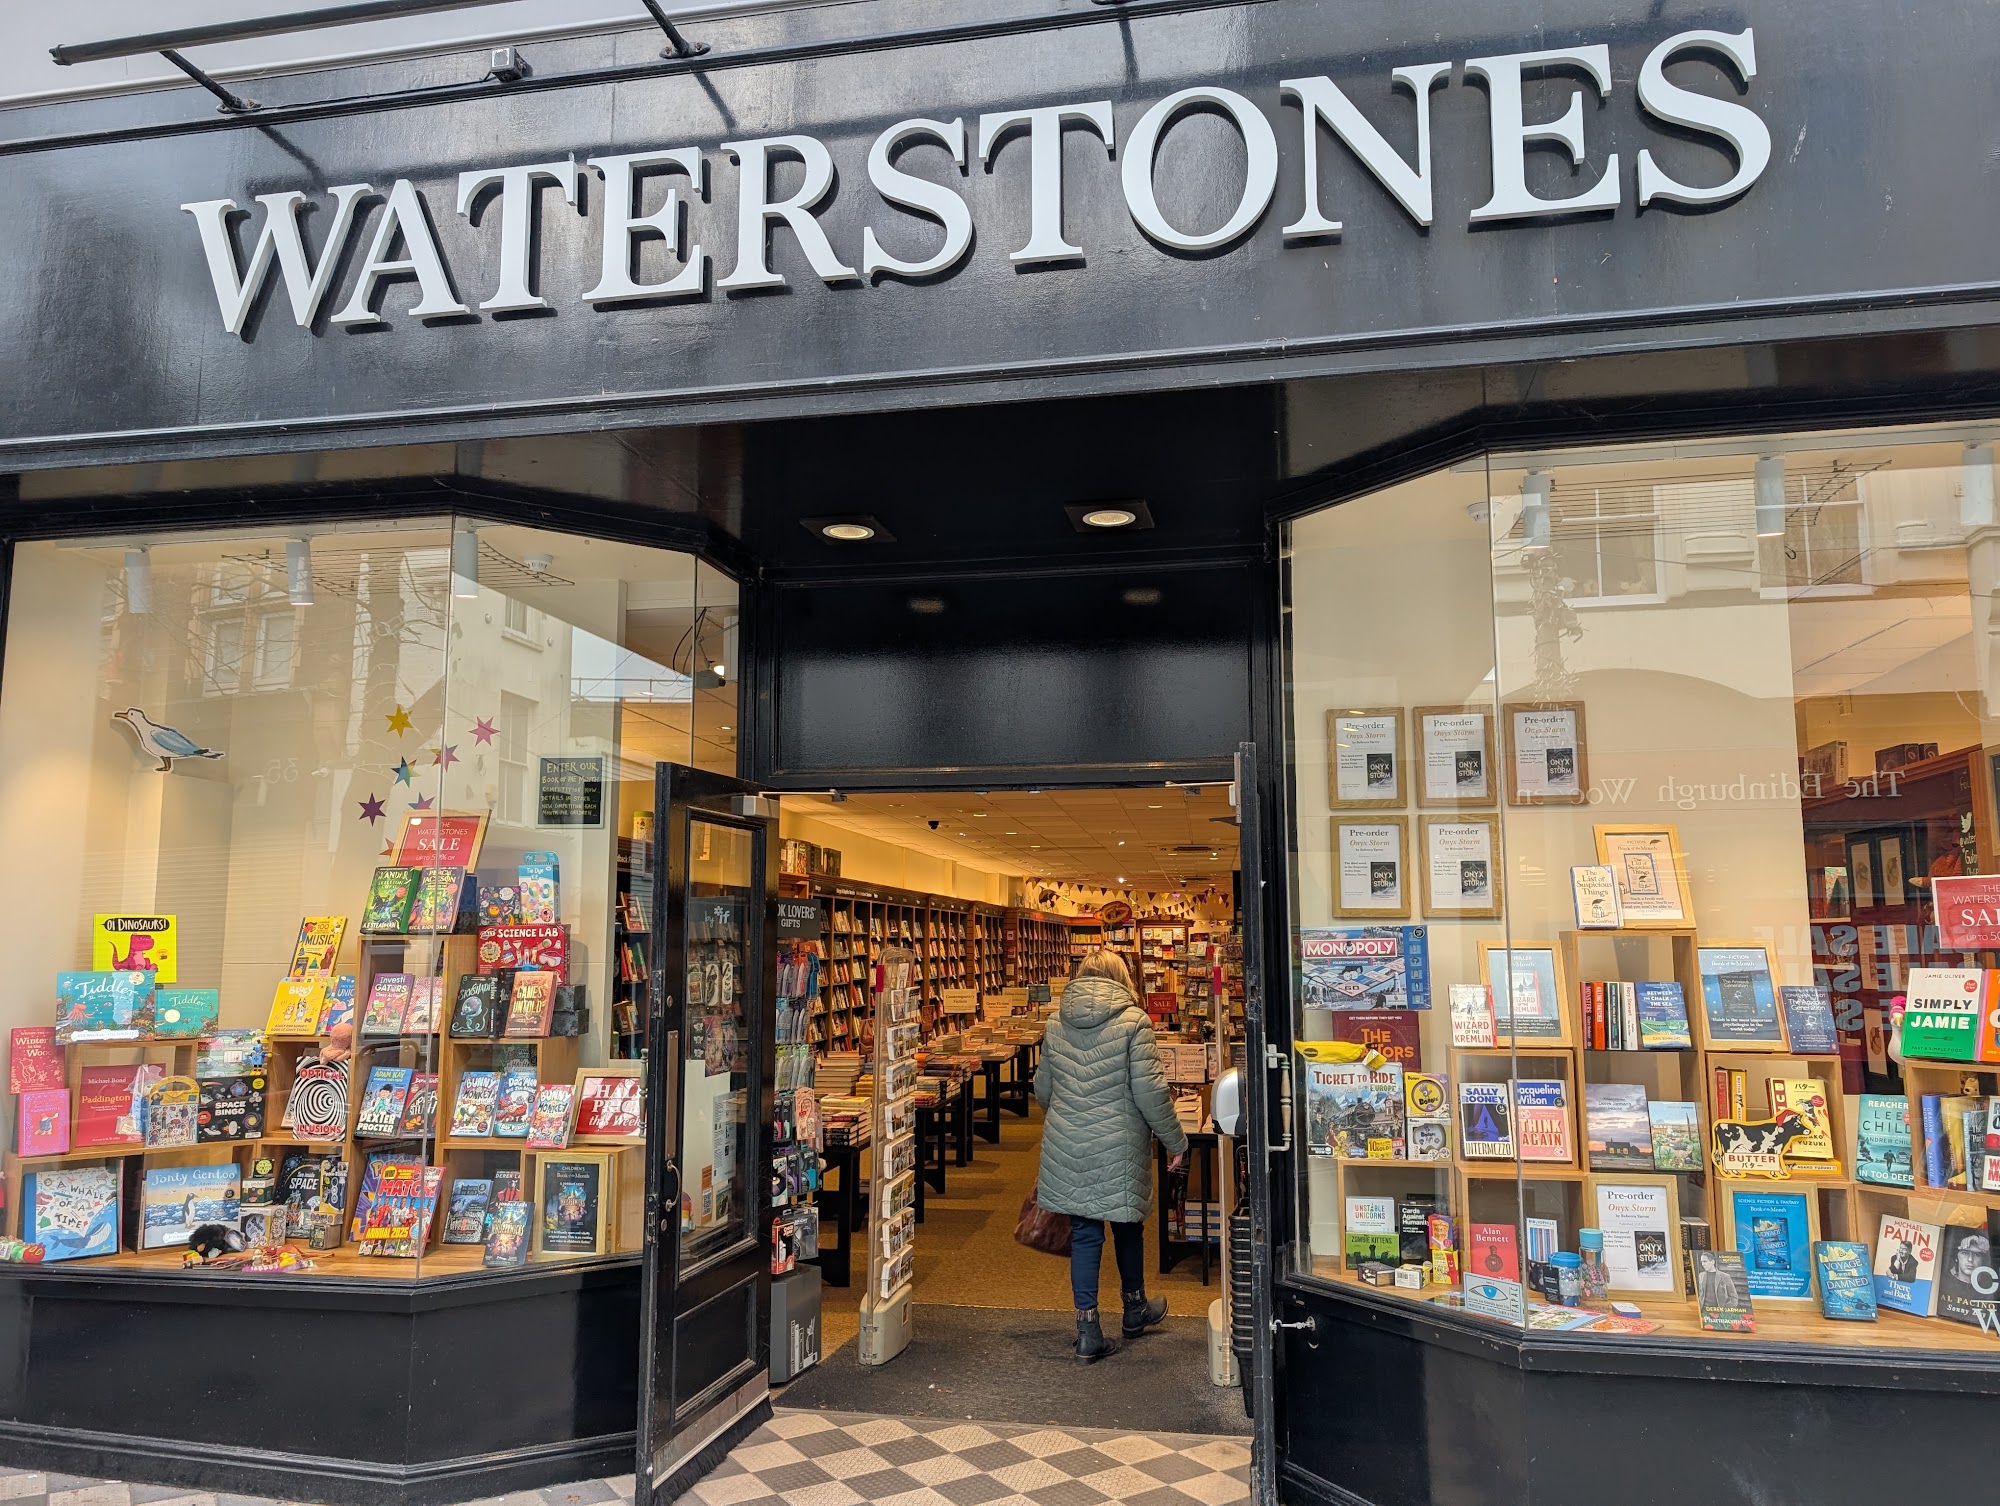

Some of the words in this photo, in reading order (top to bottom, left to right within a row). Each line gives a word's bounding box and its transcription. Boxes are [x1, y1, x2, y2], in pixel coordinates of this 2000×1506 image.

[181, 28, 1774, 338] WATERSTONES
[1524, 716, 1565, 724] Pre-order
[546, 762, 579, 773] ENTER
[580, 762, 599, 772] OUR
[1349, 829, 1389, 837] Pre-order
[1439, 828, 1479, 836] Pre-order
[416, 837, 461, 851] SALE
[1349, 839, 1367, 847] Onyx
[1438, 838, 1457, 846] Onyx
[1373, 871, 1393, 879] ONYX
[1464, 870, 1483, 878] ONYX
[1373, 880, 1395, 888] STORM
[1464, 879, 1486, 887] STORM
[1982, 884, 2000, 892] THE
[1582, 887, 1609, 897] Things
[787, 904, 817, 919] LOVERS'
[704, 911, 715, 928] by
[719, 910, 730, 925] if
[780, 918, 801, 928] GIFTS
[117, 918, 167, 931] DINOSAURS!
[497, 928, 537, 938] SCIENCE
[538, 928, 559, 937] LAB
[304, 934, 335, 946] MUSIC
[1306, 941, 1394, 956] MONOPOLY
[379, 976, 405, 984] Investi
[74, 976, 138, 999] Tiddler
[288, 985, 314, 997] BLUEY
[374, 983, 407, 993] GATORS
[516, 987, 543, 998] GAMES
[169, 994, 207, 1007] Tiddler
[1153, 1000, 1171, 1008] SALE
[1913, 998, 1973, 1010] SIMPLY
[513, 1000, 542, 1013] UNTOLD
[1454, 1021, 1490, 1030] WIZARD
[1910, 1015, 1970, 1030] JAMIE
[1361, 1028, 1392, 1043] THE
[1454, 1034, 1492, 1043] KREMLIN
[15, 1037, 48, 1046] Winter
[299, 1069, 345, 1080] OPTICAL
[392, 1071, 406, 1079] KAY
[1313, 1070, 1355, 1085] TICKET
[1356, 1073, 1367, 1083] TO
[1369, 1070, 1397, 1085] RIDE
[466, 1076, 496, 1089] BUNNY
[1369, 1084, 1397, 1092] EUROPE
[1465, 1088, 1499, 1096] SALLY
[1519, 1084, 1561, 1095] acqueline
[81, 1095, 131, 1104] Paddington
[462, 1089, 494, 1100] MONKEY
[540, 1088, 572, 1102] BUNNY
[1461, 1095, 1506, 1104] ROONEY
[215, 1100, 246, 1109] SPACE
[538, 1101, 568, 1113] MONKEY
[1868, 1100, 1909, 1110] REACHER
[214, 1107, 245, 1116] BINGO
[1874, 1110, 1903, 1120] LEE
[360, 1112, 396, 1123] DEXTER
[612, 1115, 641, 1127] Week
[296, 1124, 342, 1134] ILLUSIONS
[357, 1123, 394, 1133] PROCTER
[1519, 1119, 1563, 1134] THINK
[1522, 1133, 1562, 1147] AGAIN
[1369, 1141, 1377, 1151] 10
[1465, 1142, 1512, 1156] INTERMEZZO
[1728, 1154, 1776, 1164] BUTTER
[151, 1172, 189, 1186] Jonty
[192, 1169, 235, 1180] Gentoo
[1859, 1169, 1868, 1177] IN
[1870, 1170, 1889, 1179] TOO
[1891, 1172, 1914, 1182] DEEP
[289, 1177, 320, 1190] SPACE
[70, 1184, 104, 1200] WHALE
[1607, 1190, 1655, 1200] Pre-order
[59, 1200, 72, 1208] OF
[1354, 1203, 1386, 1213] UNSTABLE
[1608, 1203, 1630, 1213] Onyx
[1631, 1203, 1657, 1212] Storm
[53, 1212, 84, 1229] TIME
[1355, 1211, 1386, 1220] UNICORNS
[1401, 1213, 1426, 1221] Against
[1482, 1227, 1501, 1235] Alan
[1894, 1220, 1924, 1232] MICHAEL
[365, 1227, 391, 1239] ANNUAL
[391, 1226, 409, 1239] 2025
[1756, 1229, 1783, 1238] VOYAGE
[1883, 1224, 1932, 1248] PALIN
[1351, 1235, 1371, 1244] ZOMBIE
[1371, 1237, 1393, 1245] KITTENS
[1475, 1233, 1509, 1243] Bennett
[1639, 1243, 1663, 1252] ONYX
[1757, 1241, 1787, 1250] DAMNED
[1639, 1254, 1665, 1262] STORM
[1824, 1259, 1863, 1271] VOYAGE
[1826, 1278, 1869, 1290] DAMNED
[1887, 1279, 1911, 1292] There
[1883, 1288, 1893, 1296] and
[1893, 1289, 1912, 1301] Back
[1940, 1294, 1953, 1303] AL
[1957, 1296, 1997, 1311] PACINO
[1946, 1303, 1970, 1316] Sonny
